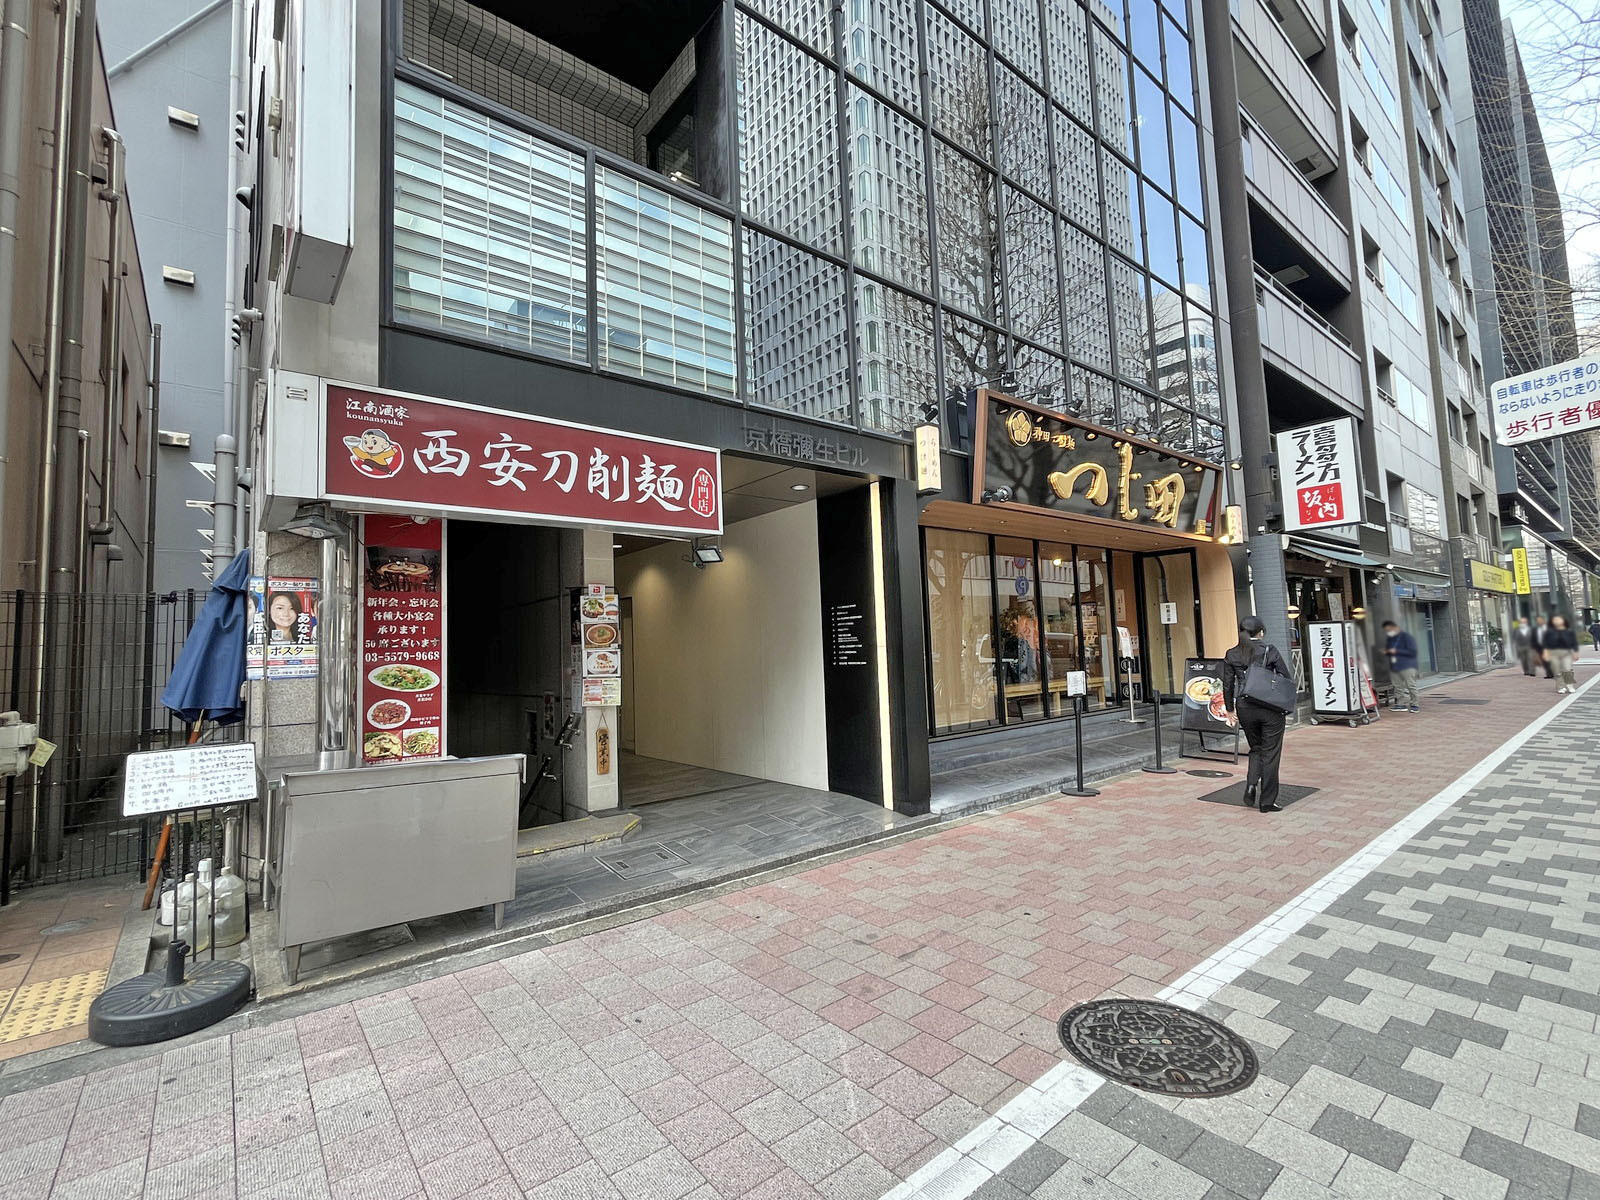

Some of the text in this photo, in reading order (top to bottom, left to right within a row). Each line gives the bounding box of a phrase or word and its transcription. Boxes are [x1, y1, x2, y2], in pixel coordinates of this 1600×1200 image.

[1496, 361, 1600, 400] 自転車は歩行者の
[345, 398, 410, 419] 江南酒家
[1499, 379, 1600, 414] ならないように走り
[346, 411, 404, 426] kounansyuka
[412, 428, 687, 513] 西安刀削麺
[1291, 430, 1316, 486] ラーメン
[697, 474, 709, 512] 専門店
[1302, 489, 1338, 518] 坂内
[367, 597, 439, 608] 新年会・忘年会
[373, 611, 434, 621] 各種大小宴会
[297, 612, 311, 644] あなた
[270, 646, 314, 656] ポスター
[365, 651, 440, 662] 03-5579-9668
